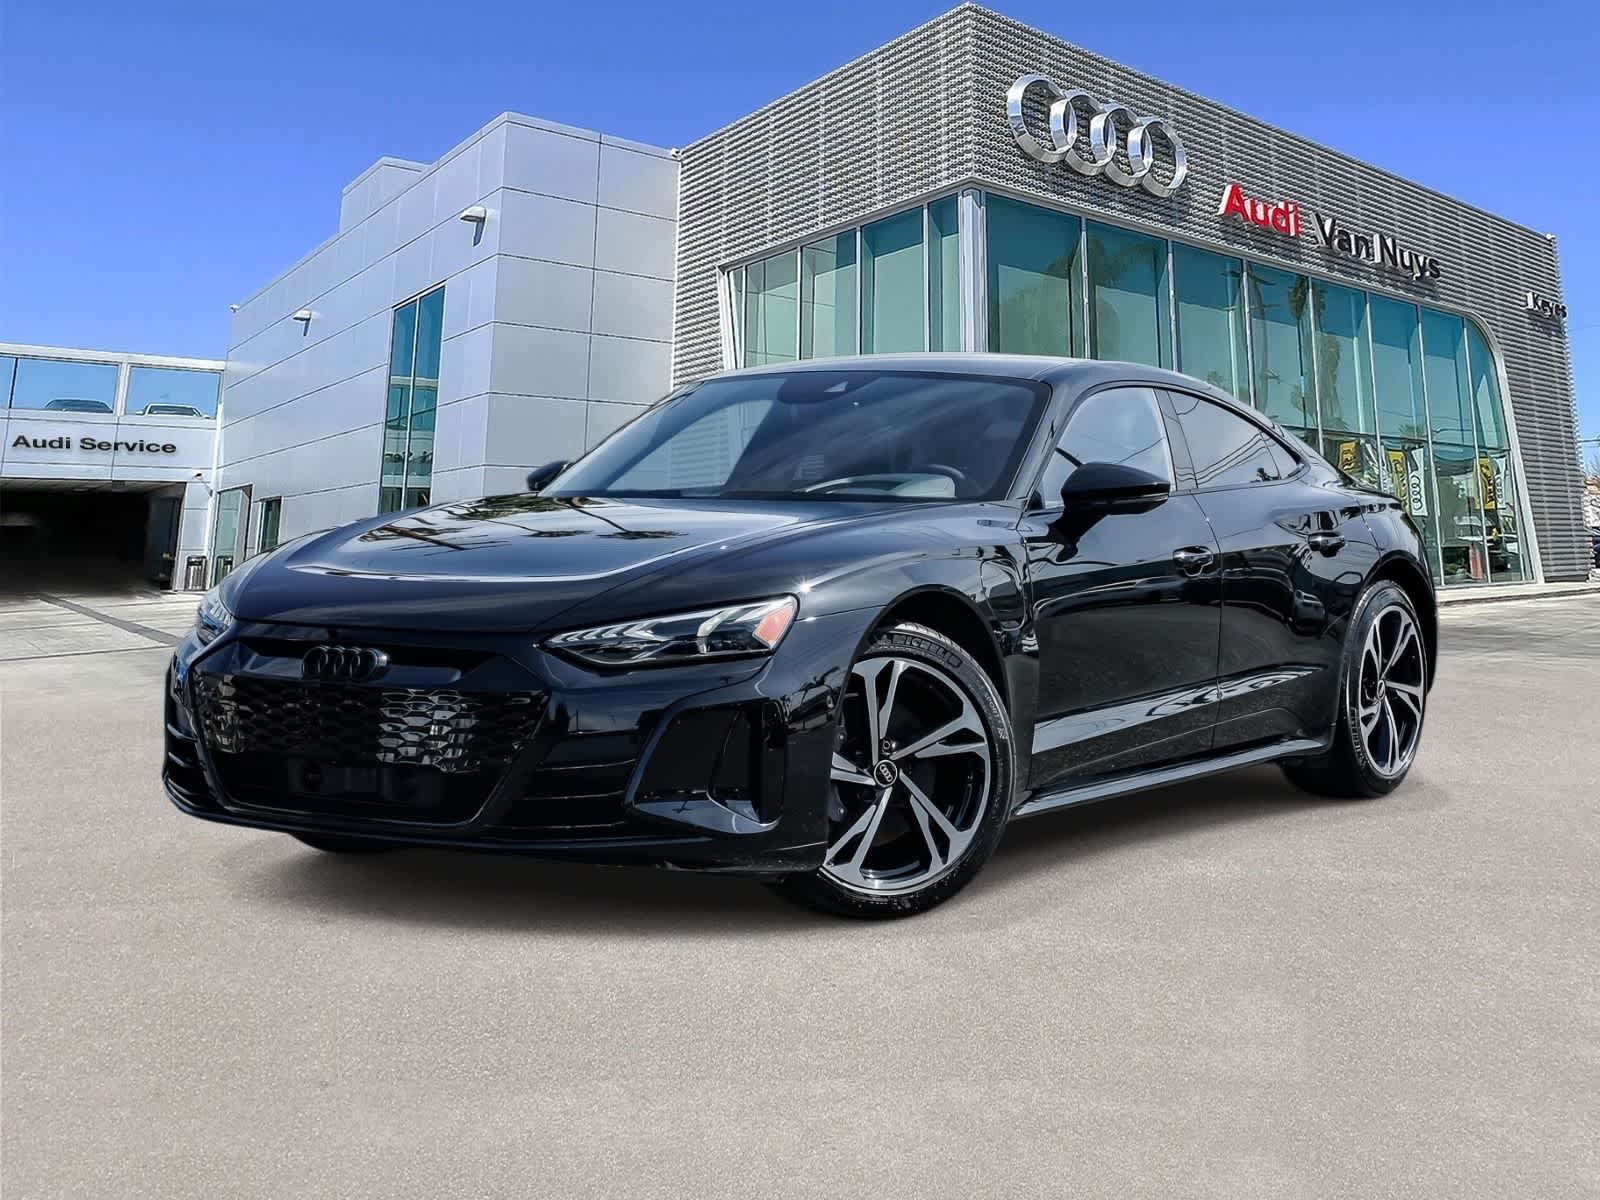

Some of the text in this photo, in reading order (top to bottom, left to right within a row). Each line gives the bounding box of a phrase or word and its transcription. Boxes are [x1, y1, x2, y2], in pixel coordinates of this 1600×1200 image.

[1218, 183, 1441, 281] Audi Van Nuys
[1527, 291, 1568, 319] Keyes
[12, 435, 177, 454] Audi Service
